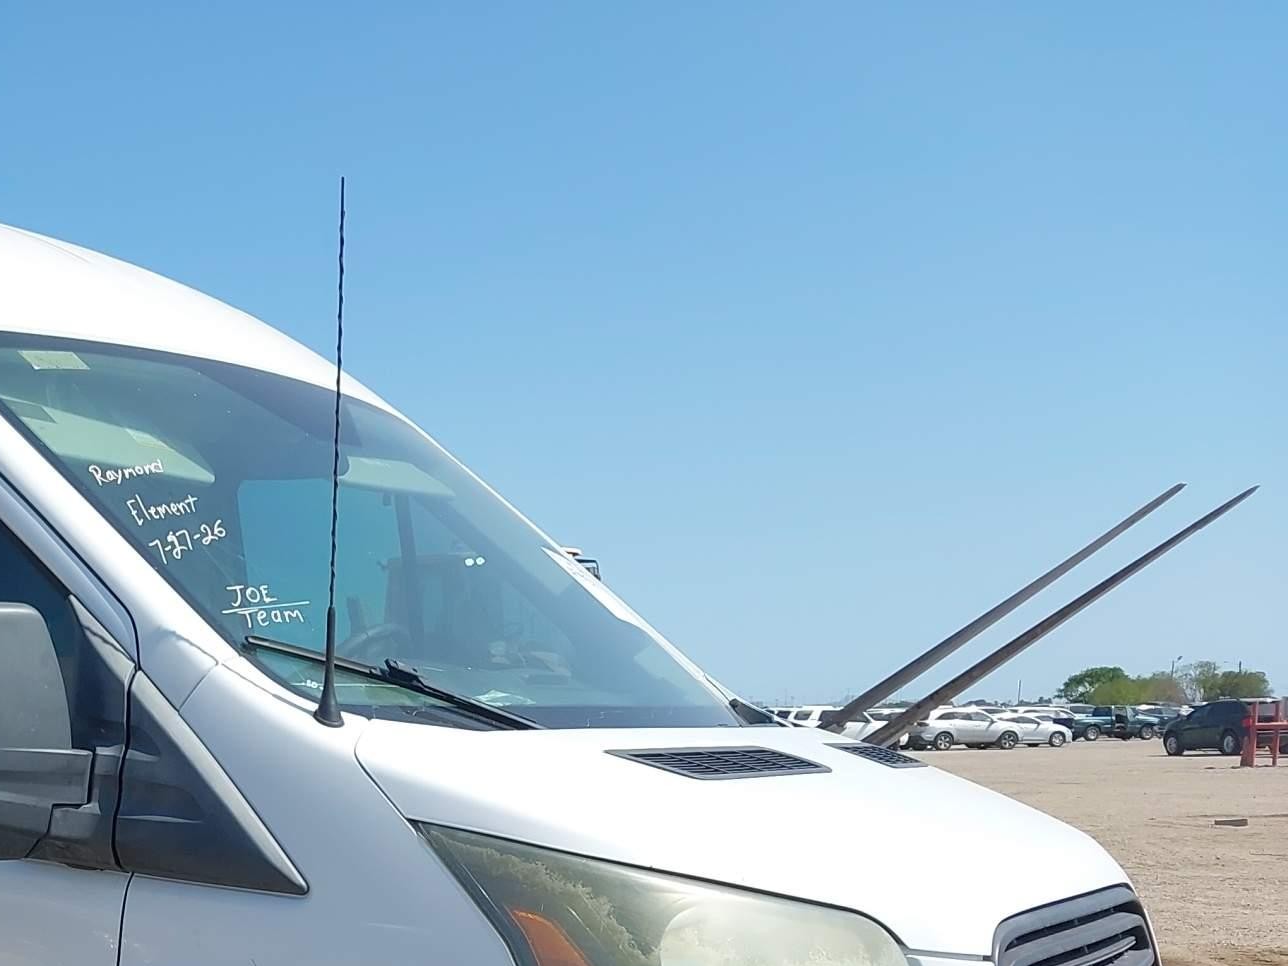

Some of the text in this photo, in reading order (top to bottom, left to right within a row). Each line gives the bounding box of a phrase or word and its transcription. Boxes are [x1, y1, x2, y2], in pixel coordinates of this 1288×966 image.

[88, 458, 164, 486] Raymond
[126, 494, 198, 526] Element
[148, 519, 226, 565] 7-27-26
[226, 585, 278, 607] JOE
[237, 608, 305, 629] Team
